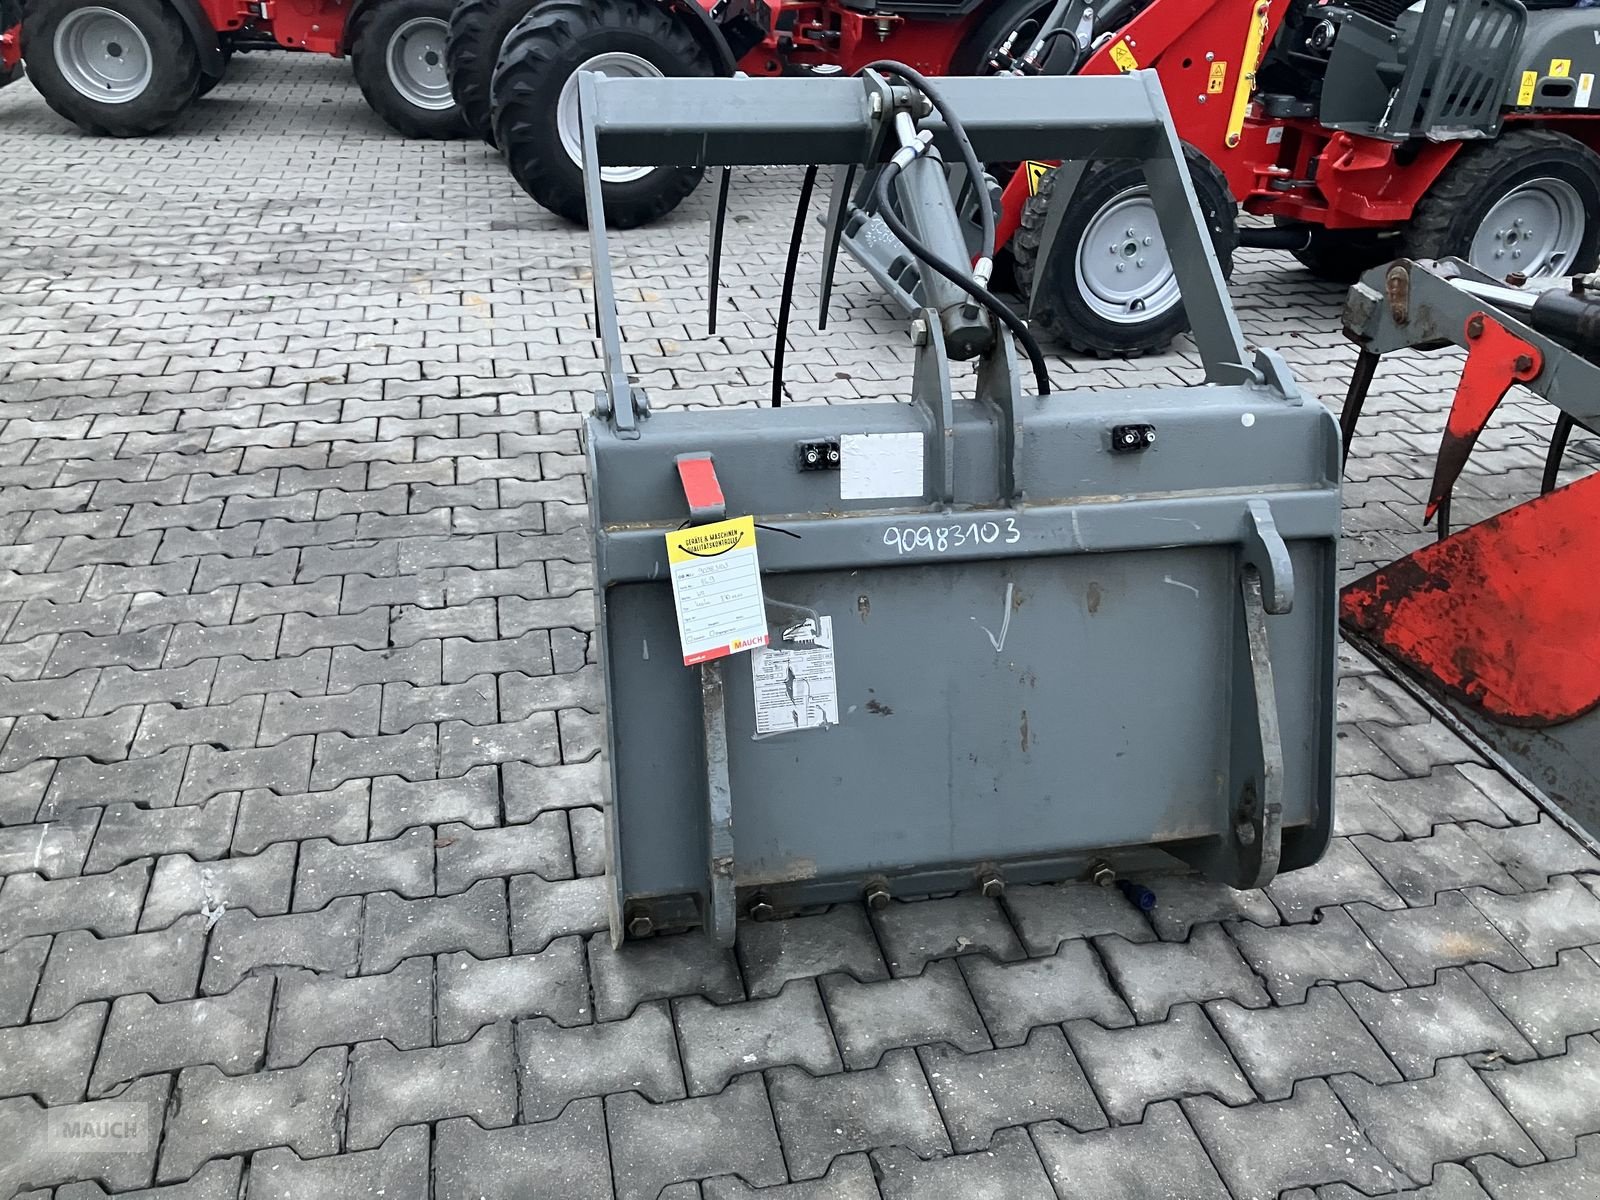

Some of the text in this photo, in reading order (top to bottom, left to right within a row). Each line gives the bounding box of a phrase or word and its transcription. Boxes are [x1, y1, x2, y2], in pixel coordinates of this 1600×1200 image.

[709, 530, 738, 541] MASCHINEN
[883, 517, 1021, 554] 90983103
[734, 636, 763, 649] MAUCH
